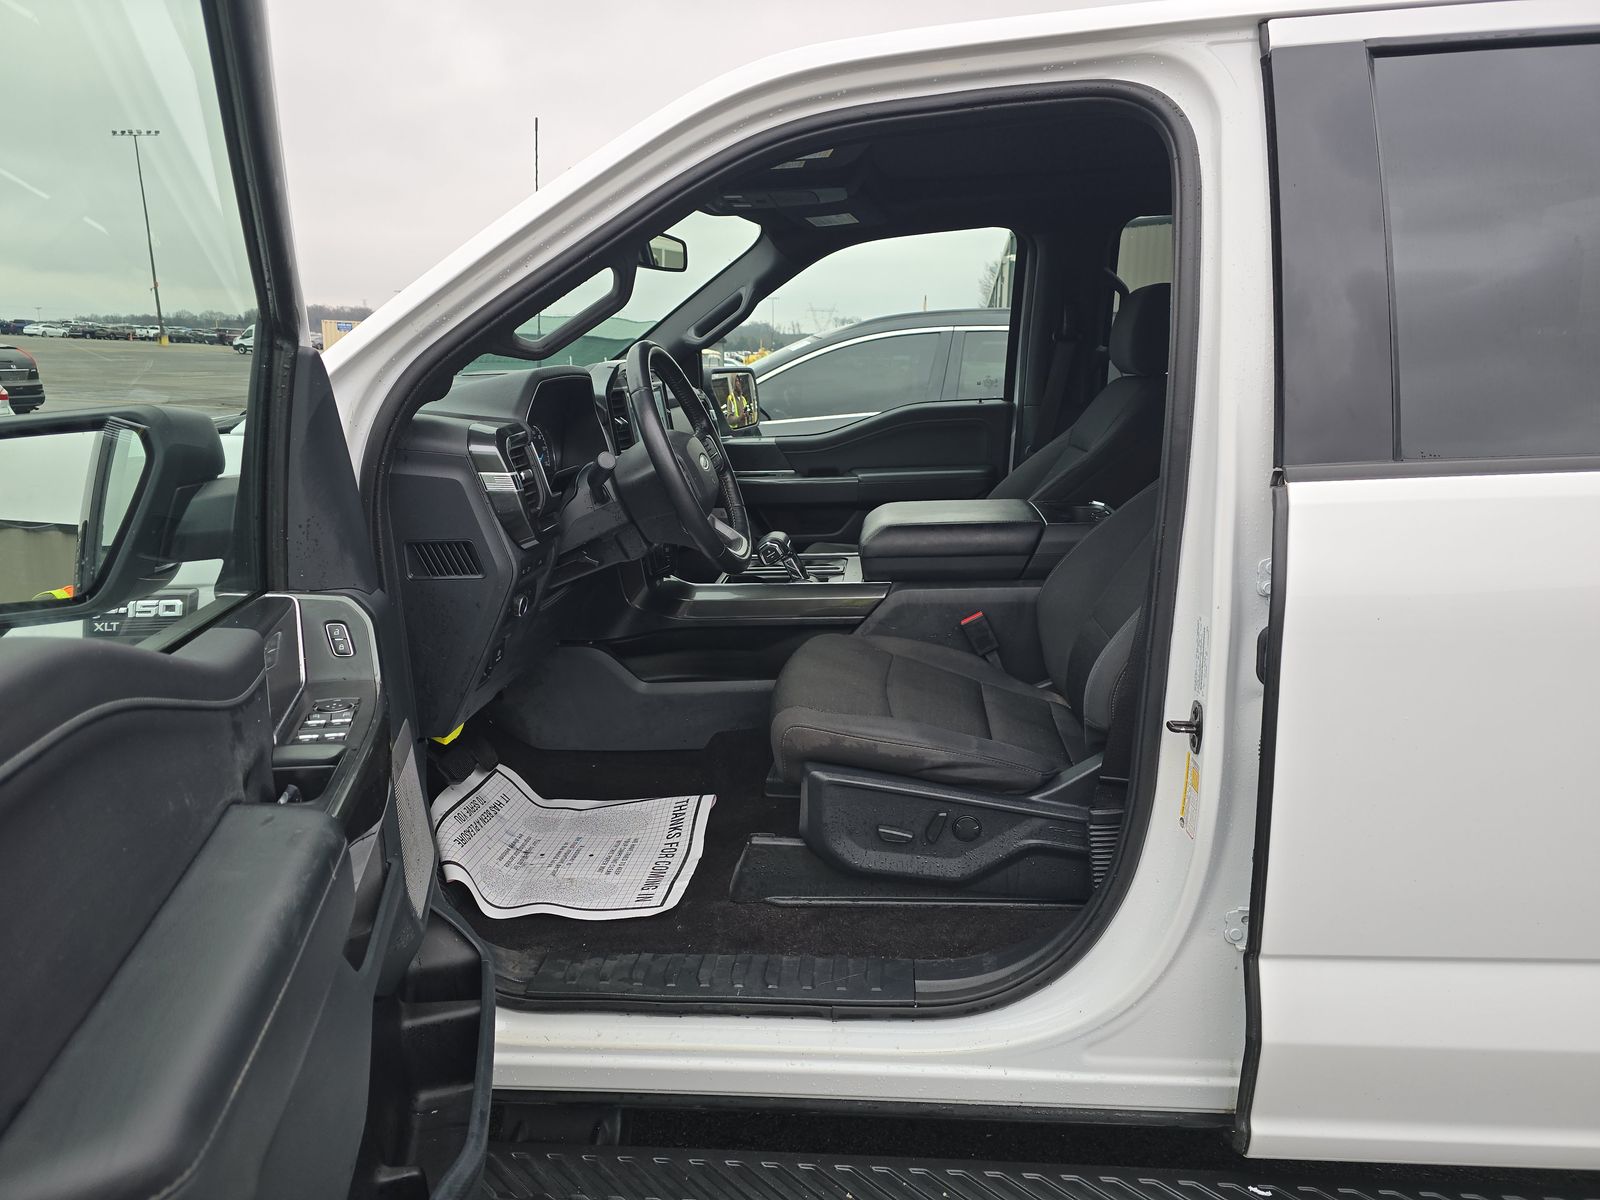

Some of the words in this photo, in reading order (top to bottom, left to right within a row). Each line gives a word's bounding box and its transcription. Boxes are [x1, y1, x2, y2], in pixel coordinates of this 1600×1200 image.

[94, 622, 119, 632] XLT
[476, 796, 486, 805] TO
[500, 793, 511, 804] IT
[464, 800, 481, 816] SERVE
[489, 800, 505, 815] HAS
[453, 811, 469, 824] YOU
[476, 819, 483, 828] A
[479, 809, 494, 825] BEEN
[666, 799, 690, 839] THANKS
[453, 821, 480, 848] PLEASURE
[658, 842, 679, 858] FOR
[641, 861, 671, 890] COMING
[635, 893, 655, 902] IN
